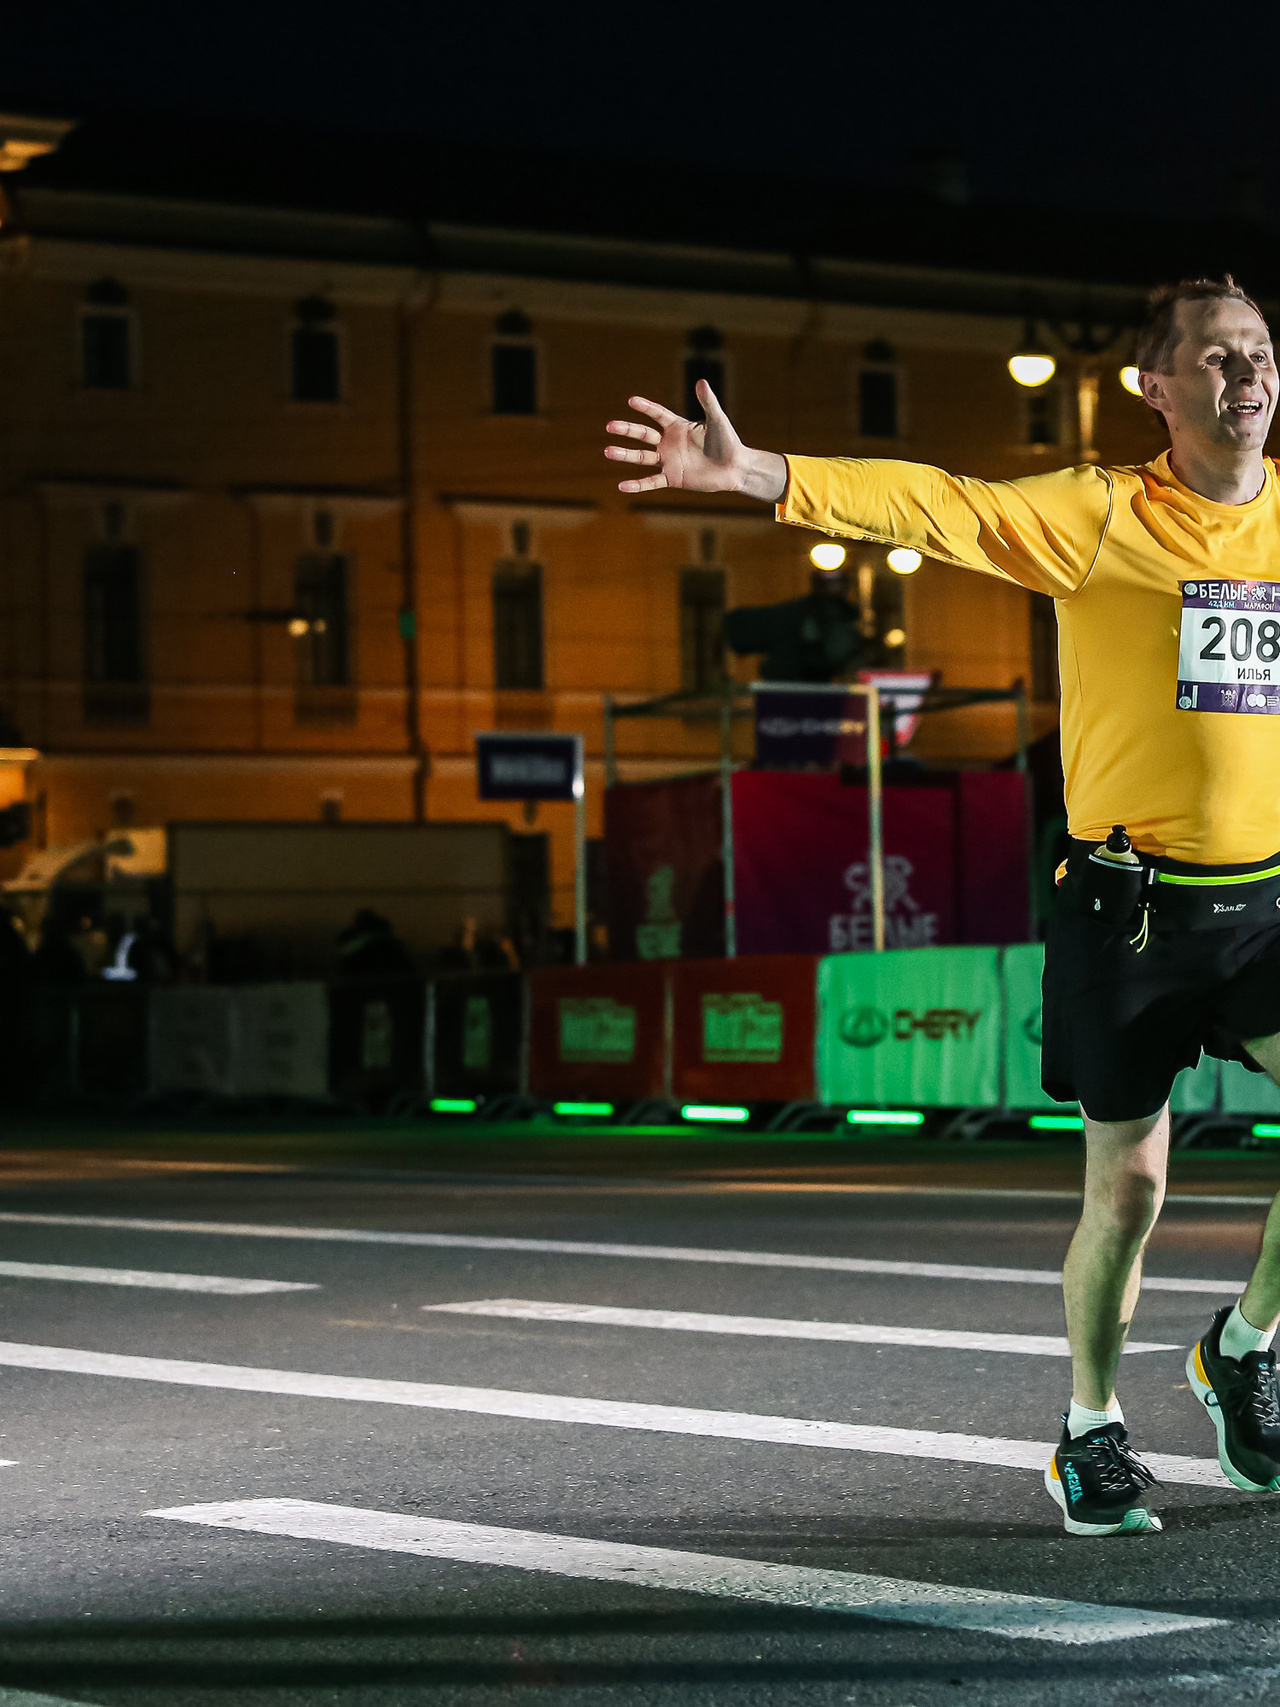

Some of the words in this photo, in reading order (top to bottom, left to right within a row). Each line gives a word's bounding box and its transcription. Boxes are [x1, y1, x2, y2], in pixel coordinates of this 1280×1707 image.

[1199, 584, 1248, 600] БЕЛЫЕ
[1237, 667, 1271, 681] ИЛЬЯ
[894, 1008, 983, 1041] CHERY
